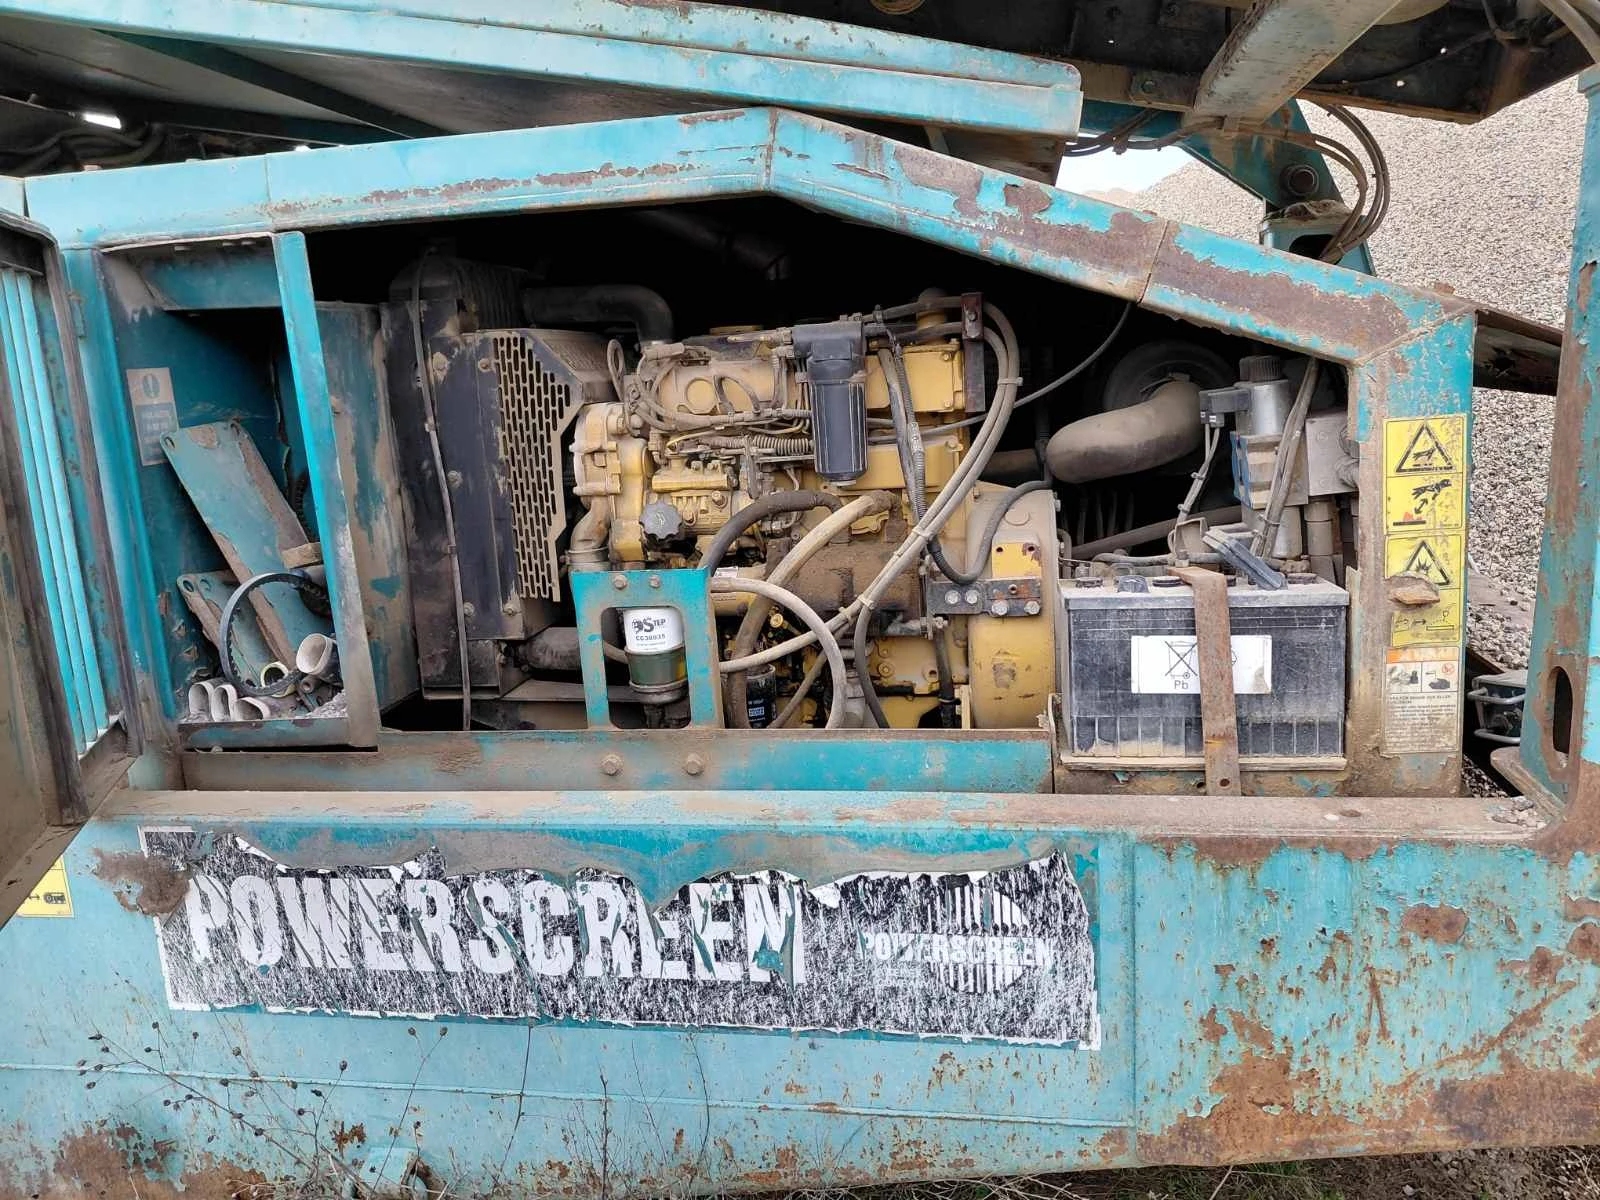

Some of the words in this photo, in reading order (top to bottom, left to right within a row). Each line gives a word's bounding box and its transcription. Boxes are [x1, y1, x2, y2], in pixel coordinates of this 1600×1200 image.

[1173, 679, 1189, 690] Pb
[185, 874, 803, 986] POWERSCREEN
[860, 932, 1054, 966] POWERSCREEN
